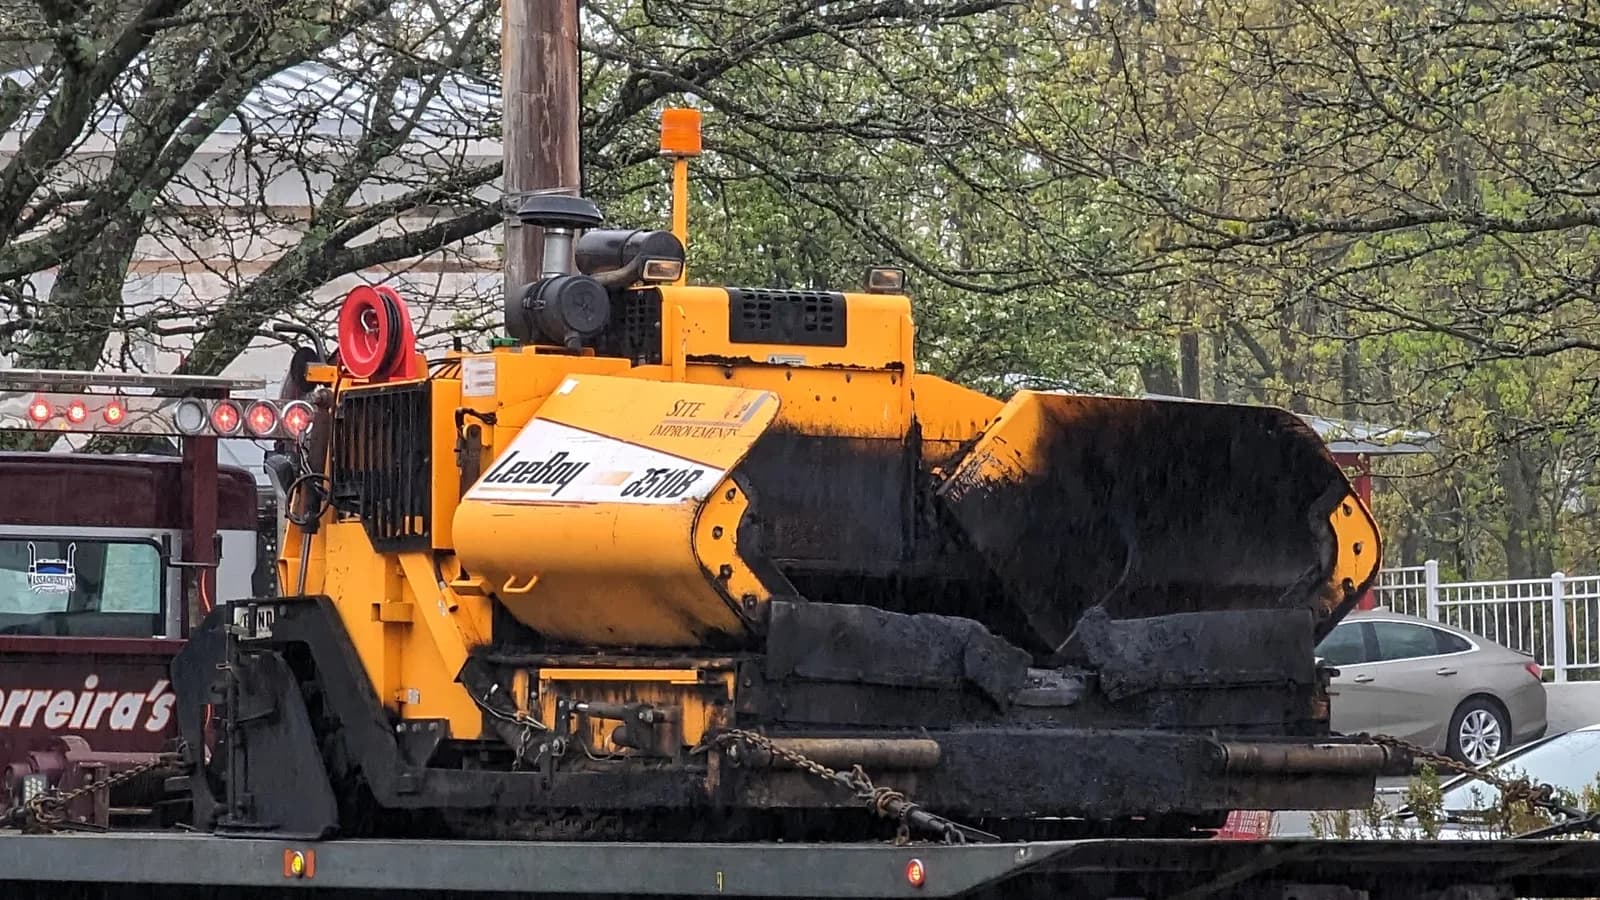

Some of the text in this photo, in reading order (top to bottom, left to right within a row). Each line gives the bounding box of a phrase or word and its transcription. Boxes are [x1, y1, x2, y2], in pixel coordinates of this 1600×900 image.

[666, 399, 705, 418] SITE
[483, 450, 591, 497] LeeBoy
[27, 573, 75, 591] MASSACHUSETTS
[0, 674, 176, 731] rreira's
